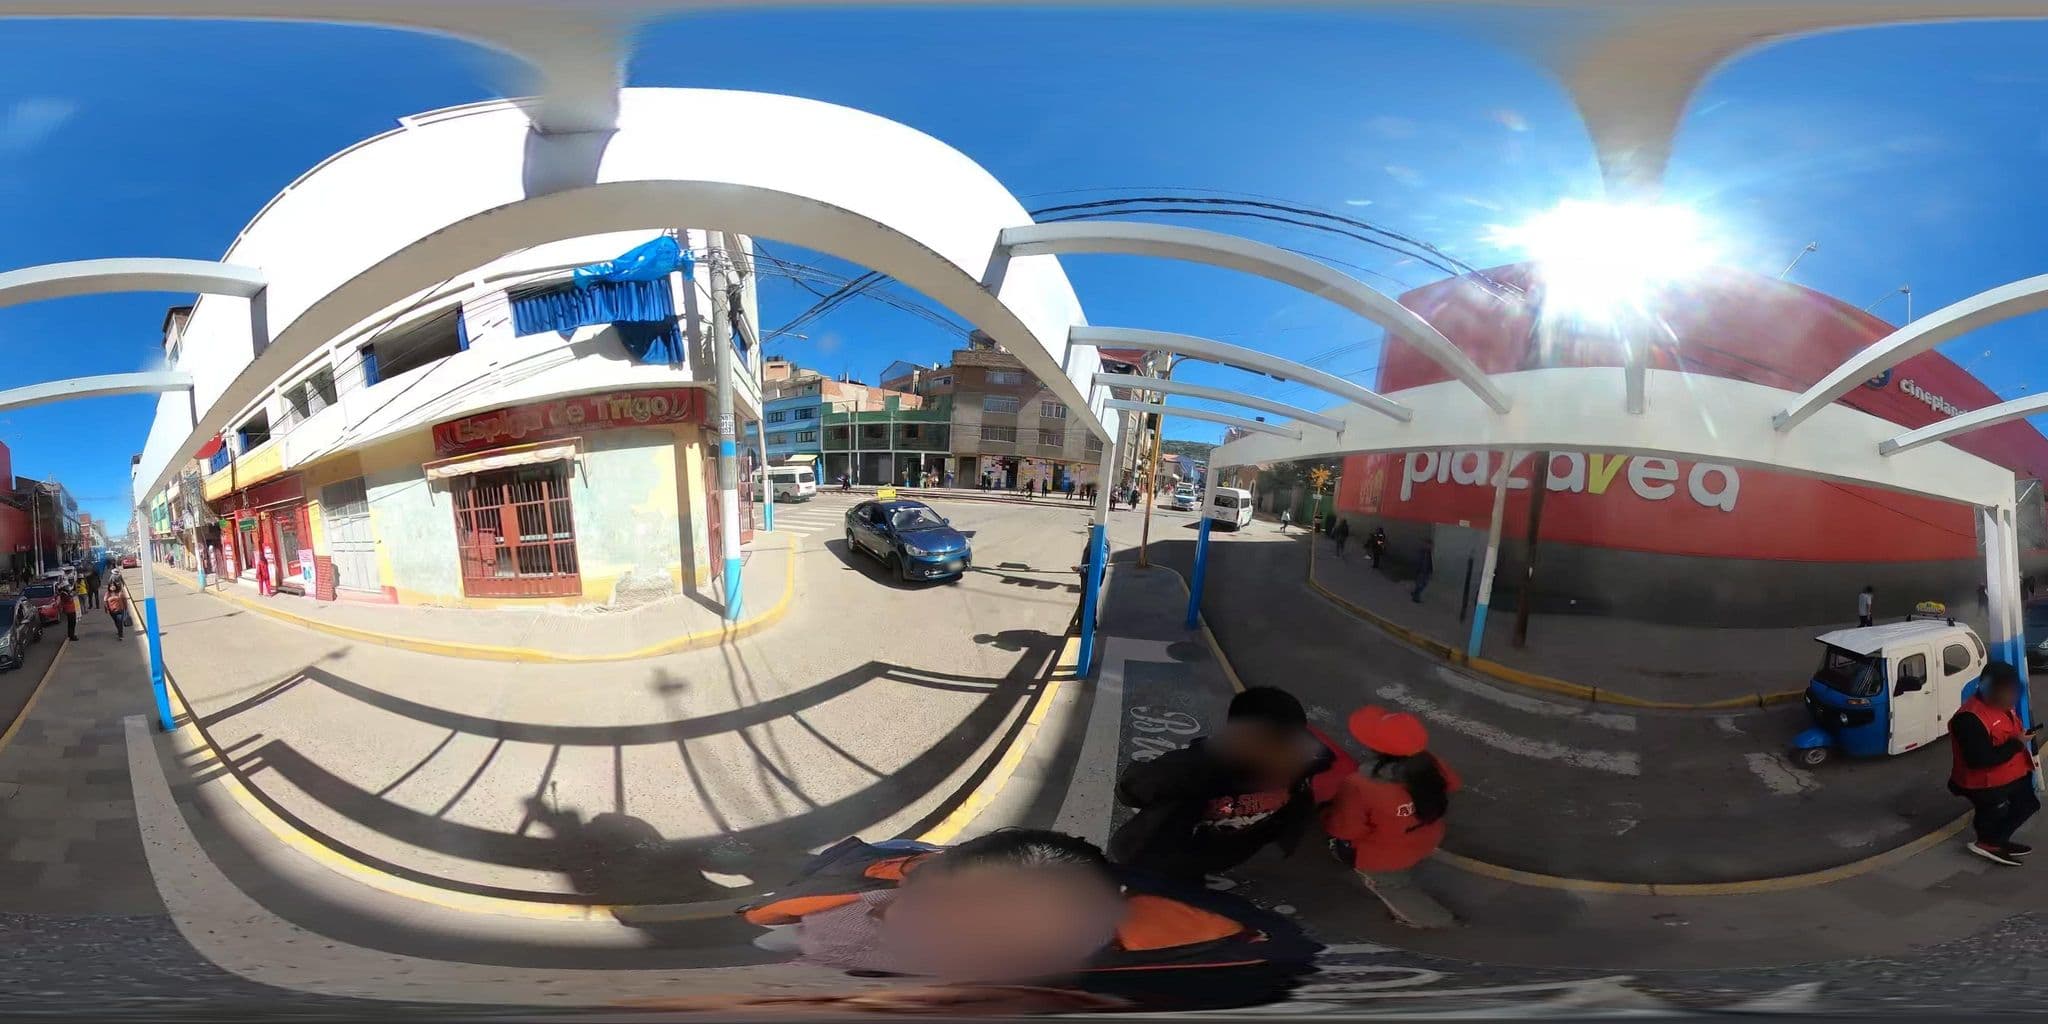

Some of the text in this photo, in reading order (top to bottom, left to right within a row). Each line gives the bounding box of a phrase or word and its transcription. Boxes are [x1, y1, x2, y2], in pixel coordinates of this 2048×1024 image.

[460, 412, 543, 442] Espiga
[550, 399, 585, 425] de
[590, 394, 667, 422] Trigo
[1900, 379, 1968, 417] cineplan
